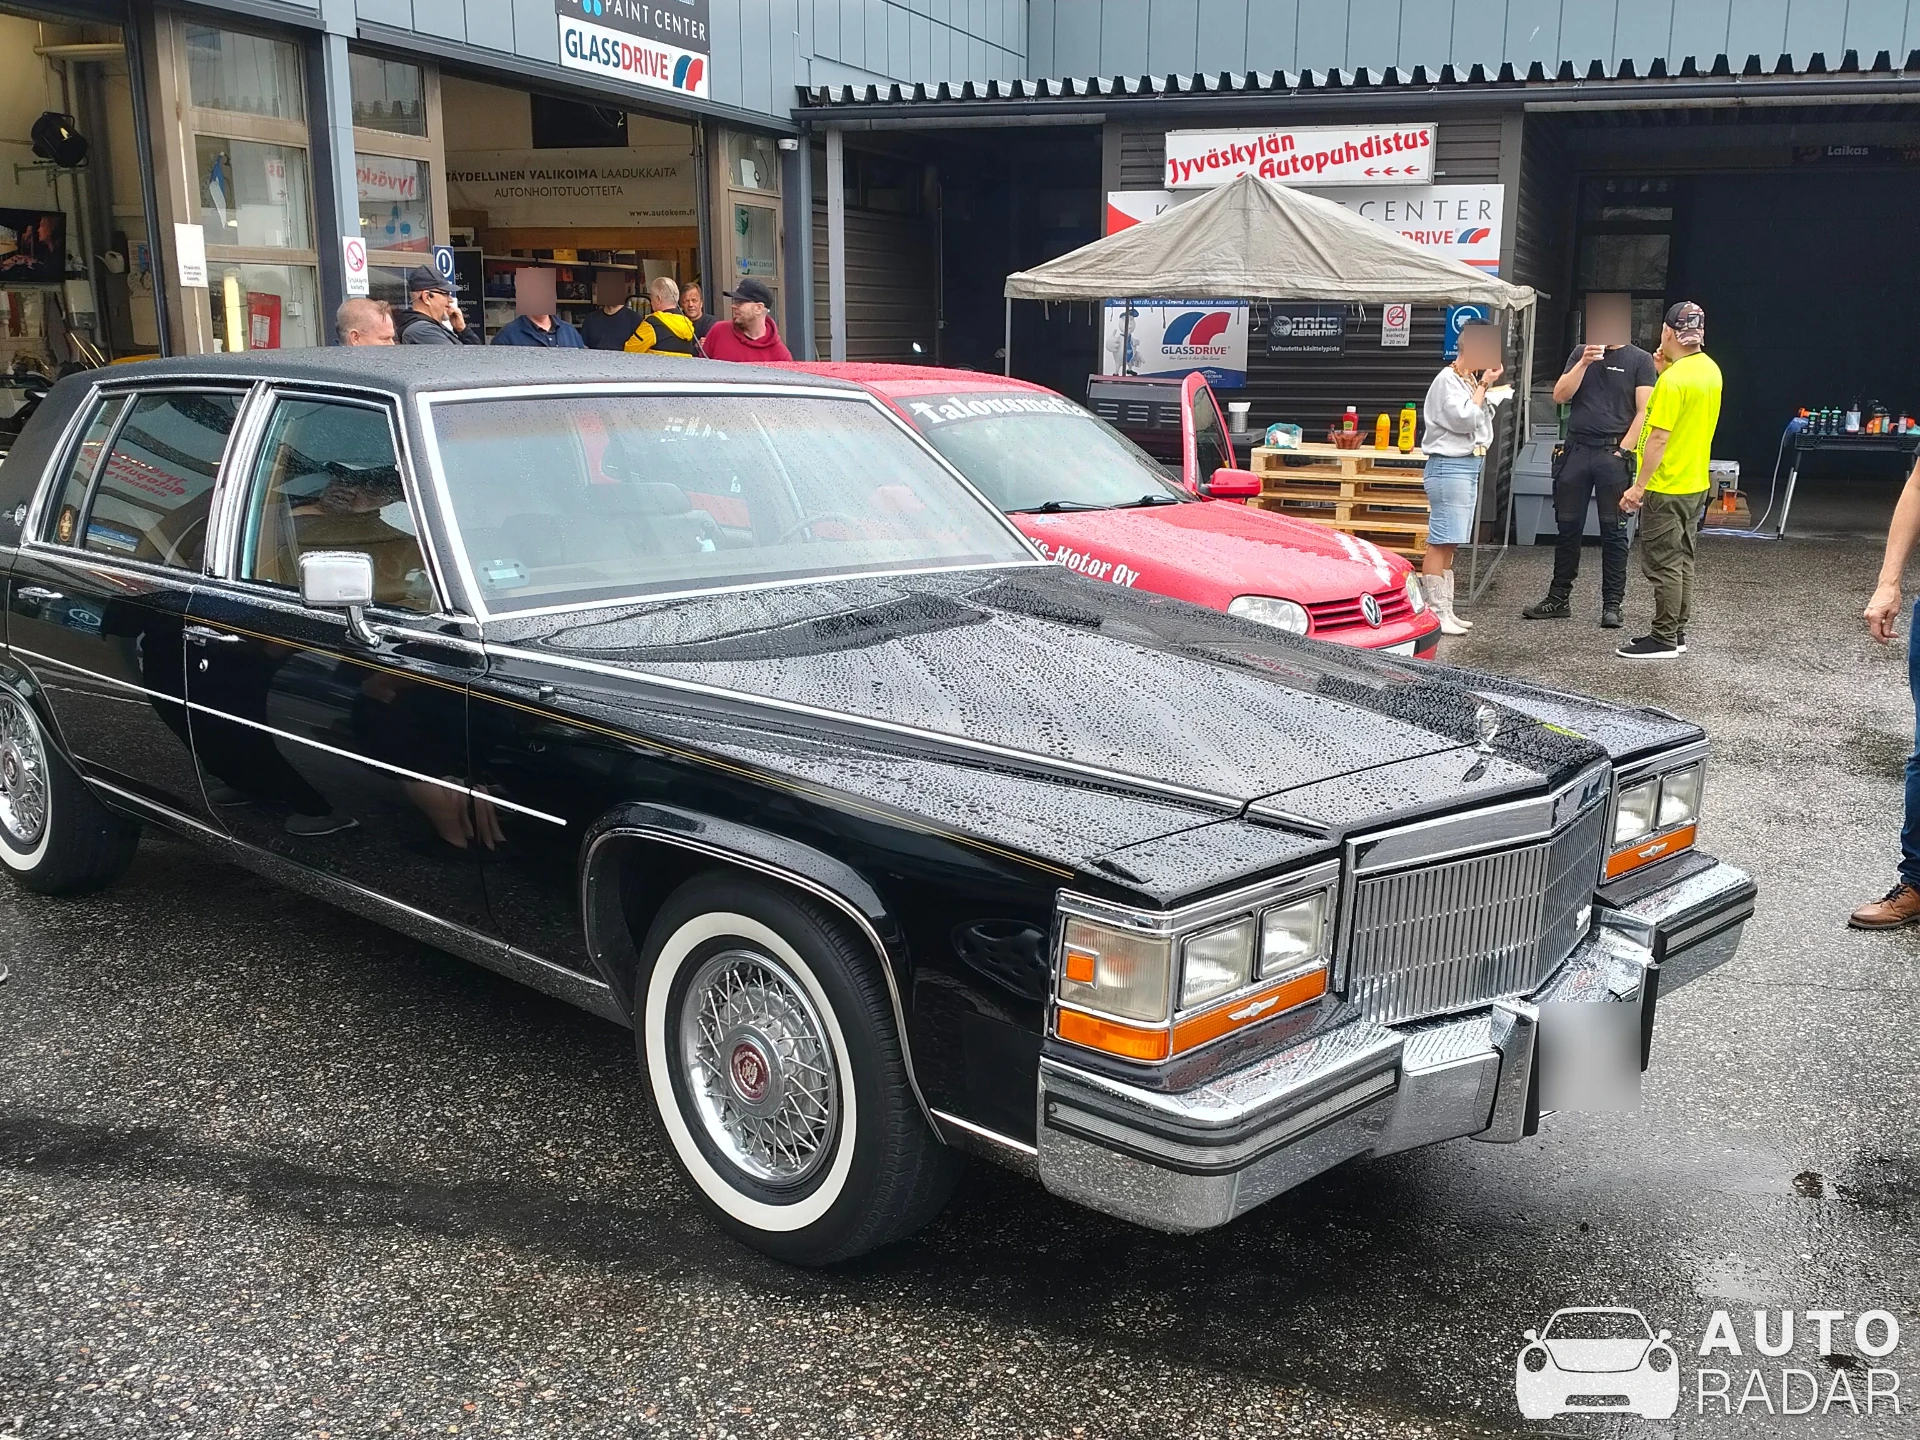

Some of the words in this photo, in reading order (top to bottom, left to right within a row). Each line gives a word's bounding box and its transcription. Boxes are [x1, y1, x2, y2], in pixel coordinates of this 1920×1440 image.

[605, 0, 649, 23] PAINT
[655, 10, 706, 41] CENTER
[1168, 132, 1295, 184] Jyväskylän
[1259, 129, 1430, 179] Autopuhdistus
[1827, 145, 1869, 156] Laikas
[445, 168, 525, 182] TÄYDELLINEN
[529, 168, 598, 180] VALIKOIMA
[601, 167, 678, 179] LAADUKKAITA
[494, 185, 624, 198] AUTONHOITOTUOTTEITA
[629, 209, 696, 217] www.autokem.fi
[1359, 199, 1492, 221] CENTER
[1291, 329, 1338, 337] CERAMIC
[1303, 345, 1340, 353] käsittelypiste
[1112, 563, 1141, 588] Oy
